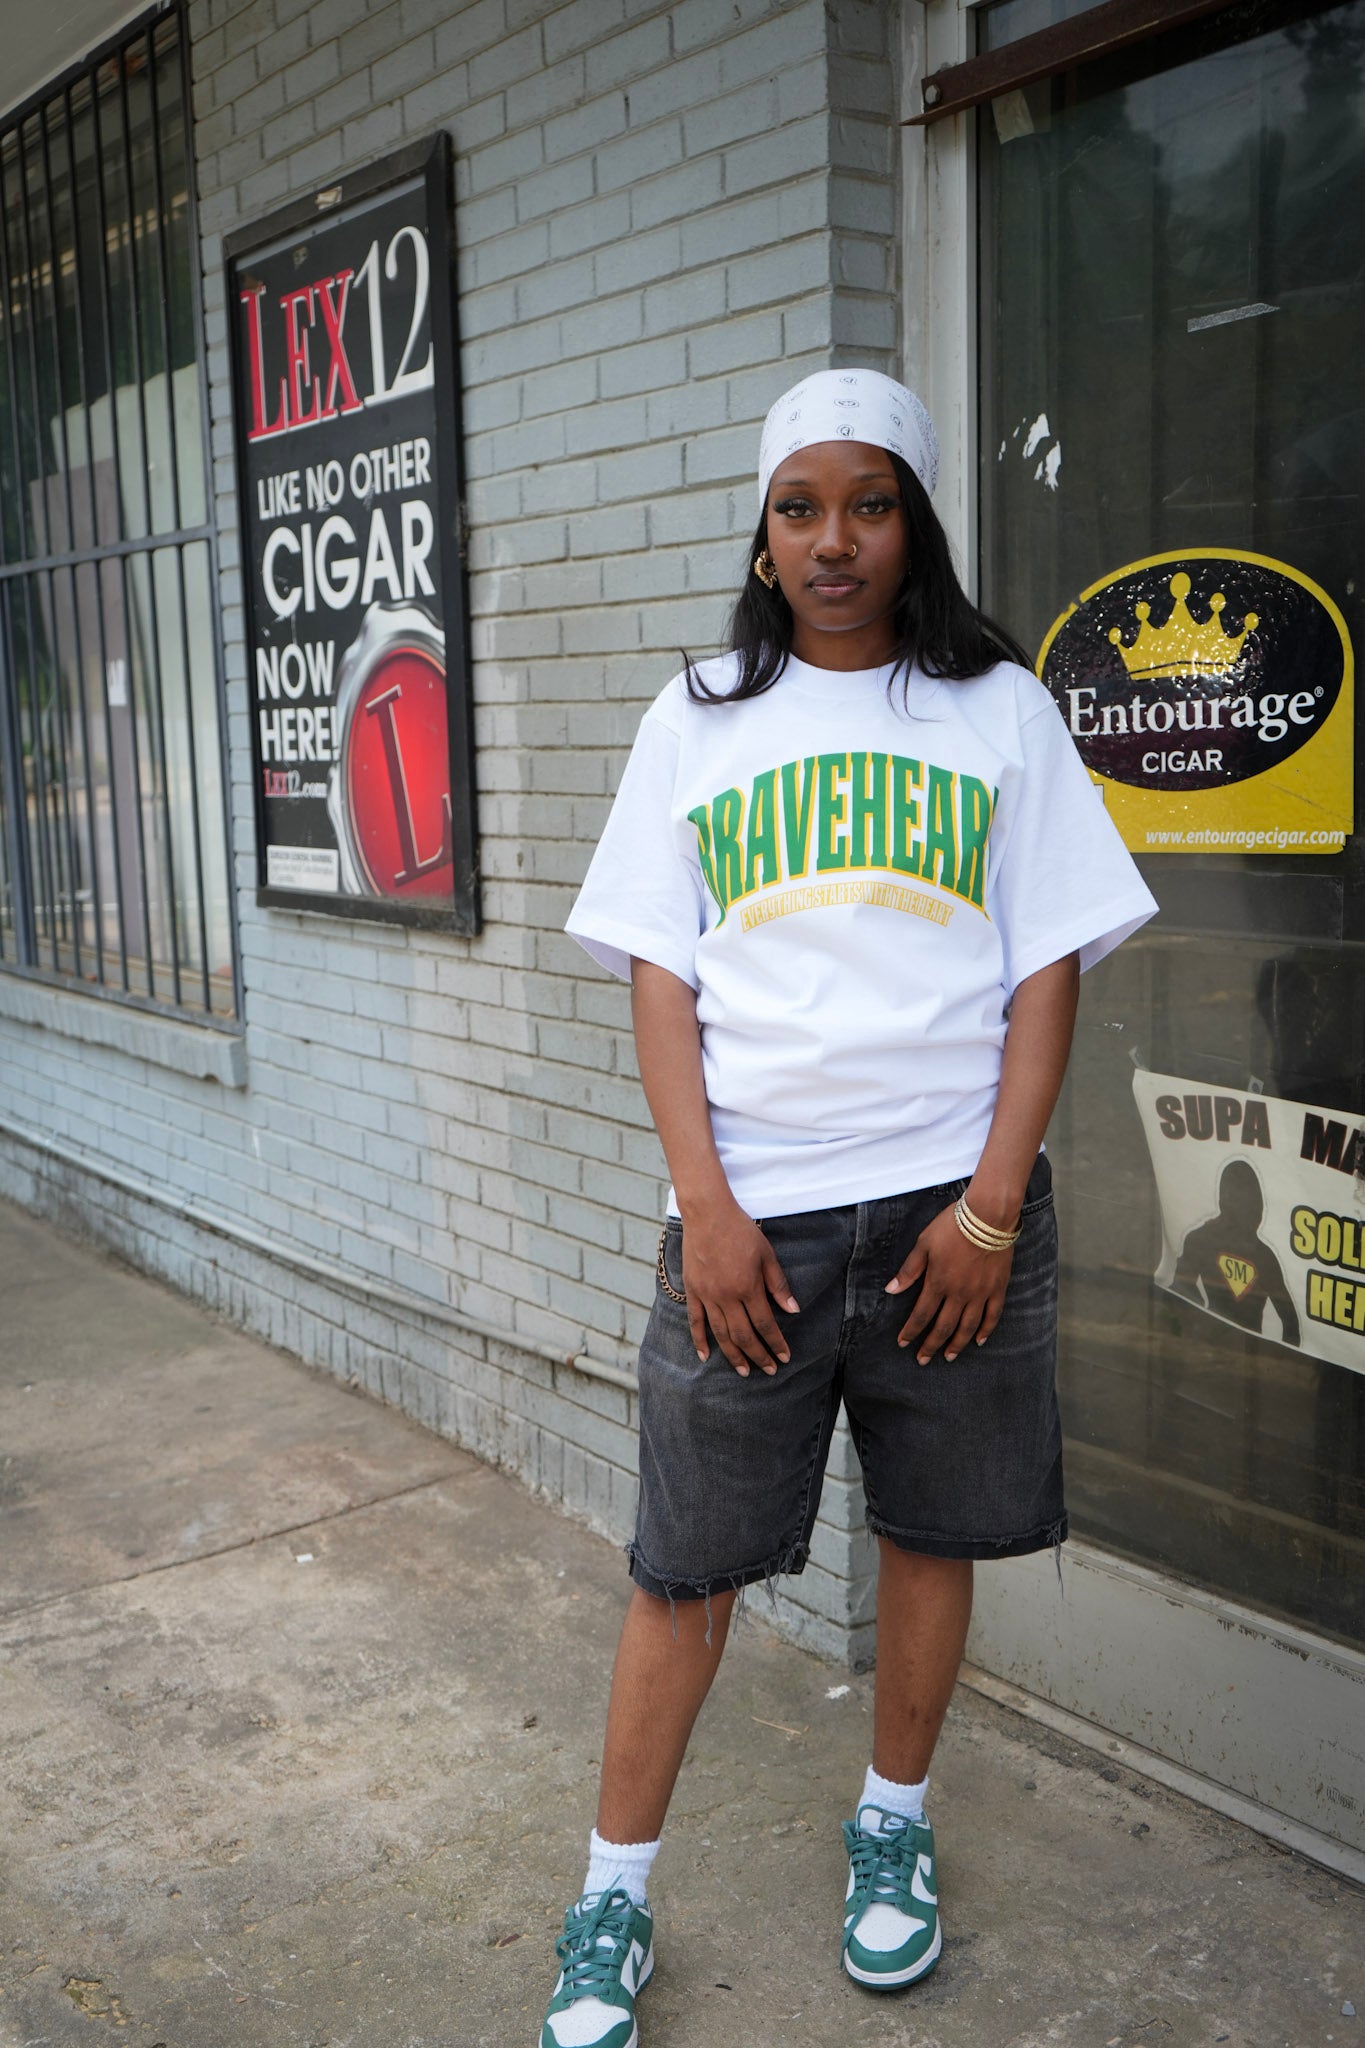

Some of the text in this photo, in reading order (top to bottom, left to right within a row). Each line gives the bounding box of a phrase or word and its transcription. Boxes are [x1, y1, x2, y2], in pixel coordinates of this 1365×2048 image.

[258, 437, 431, 520] LIKE NO OTHER
[262, 500, 436, 618] CIGAR
[256, 640, 335, 699] NOW
[259, 705, 339, 762] HERE!
[1142, 750, 1224, 773] CIGAR
[1146, 827, 1345, 849] www.entouragecigar.com
[740, 886, 813, 933] EVERYTHING
[813, 881, 863, 907] STARTS
[863, 881, 893, 909] WITH
[917, 892, 954, 927] HEART
[1155, 1095, 1272, 1149] SUPA
[1291, 1205, 1365, 1276] SOL
[1224, 1258, 1248, 1284] SM
